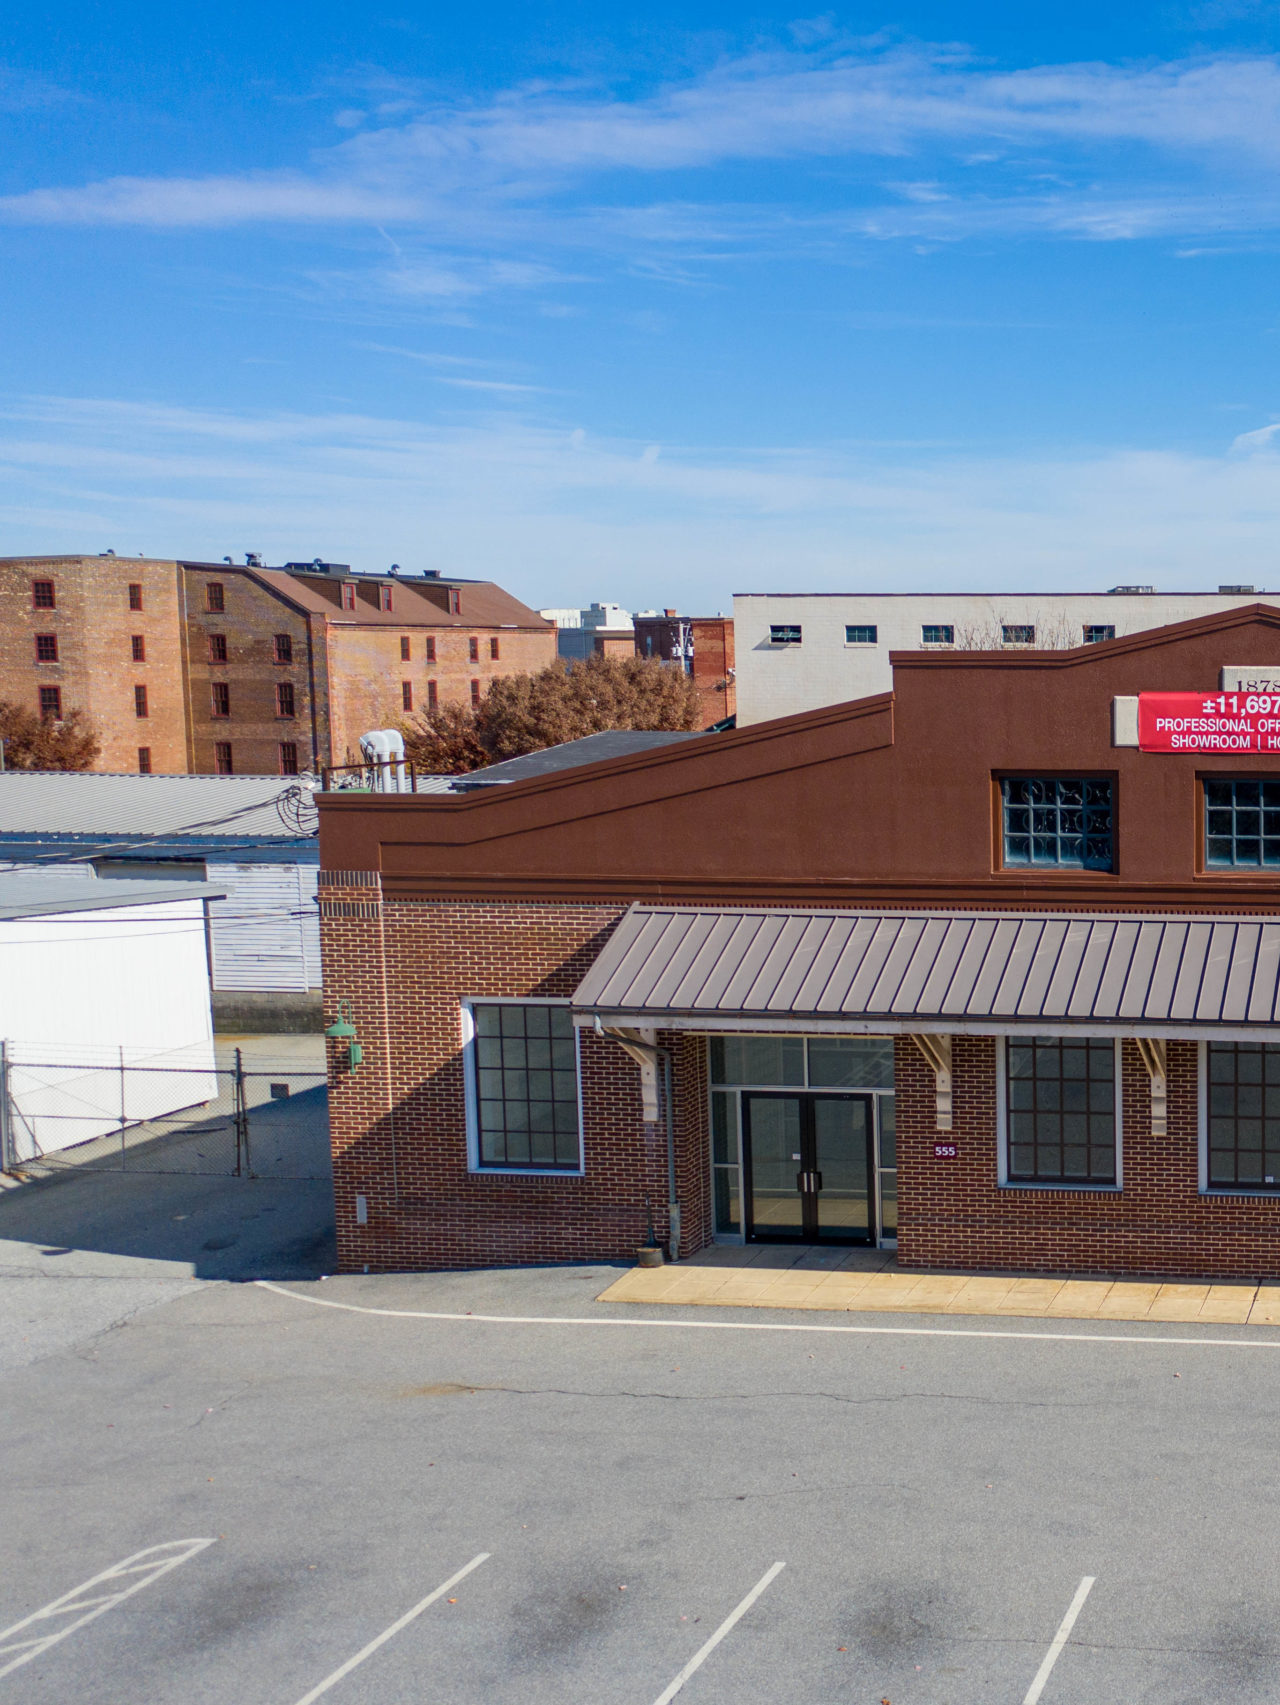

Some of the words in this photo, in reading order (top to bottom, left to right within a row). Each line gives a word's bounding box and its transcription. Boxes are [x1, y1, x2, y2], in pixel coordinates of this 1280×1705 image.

[1156, 718, 1255, 732] PROFESSIONAL
[1171, 734, 1251, 748] SHOWROOM
[935, 1146, 956, 1156] 555
